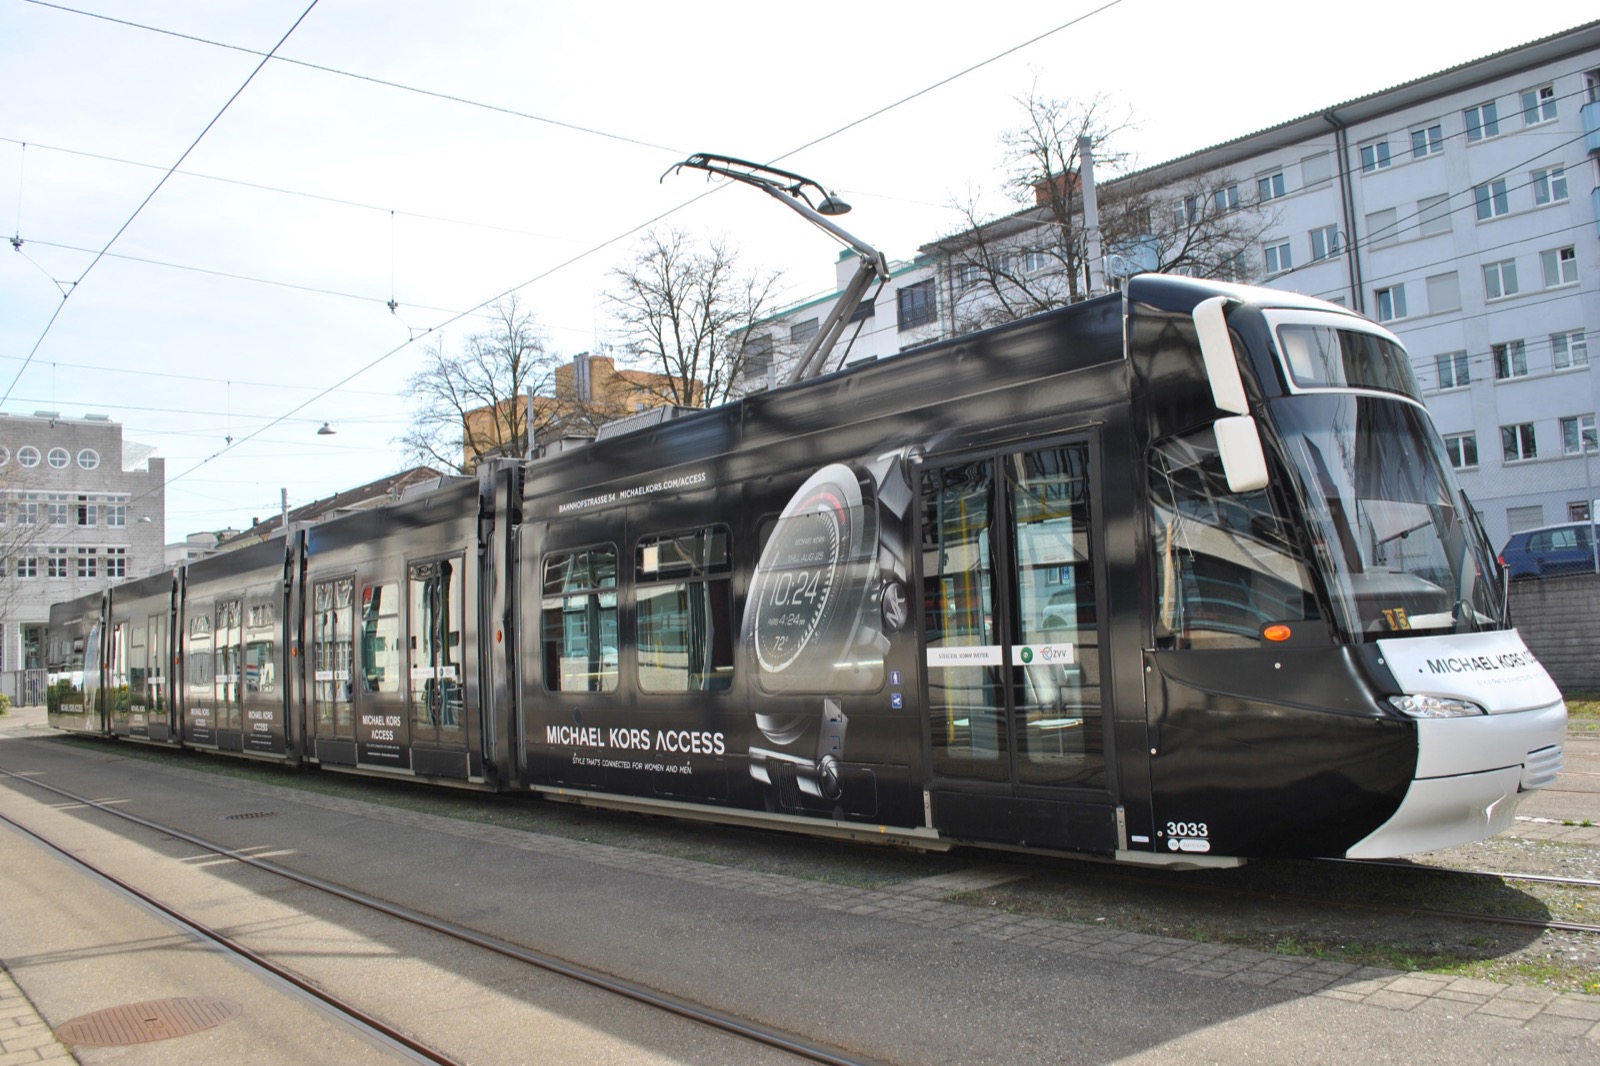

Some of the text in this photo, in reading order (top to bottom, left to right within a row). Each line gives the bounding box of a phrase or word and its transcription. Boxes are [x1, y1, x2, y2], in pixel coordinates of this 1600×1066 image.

[558, 472, 706, 513] BAHNHOFSTRASSE 54 MICHAELKORS.COM/ACCESS
[769, 570, 821, 606] 10:24
[1053, 649, 1067, 658] ZVV
[1426, 655, 1498, 675] MICHAEL
[1496, 653, 1526, 670] KORS
[362, 714, 401, 727] MICHAEL KORS
[371, 729, 394, 741] ACCESS
[546, 725, 726, 755] MICHAEL KORS ACCESS
[572, 757, 585, 766] STYLE
[586, 758, 601, 767] THAT'S
[632, 761, 643, 770] FOR
[644, 763, 664, 772] WOMEN
[666, 765, 678, 774] AND
[1166, 821, 1209, 837] 3033
